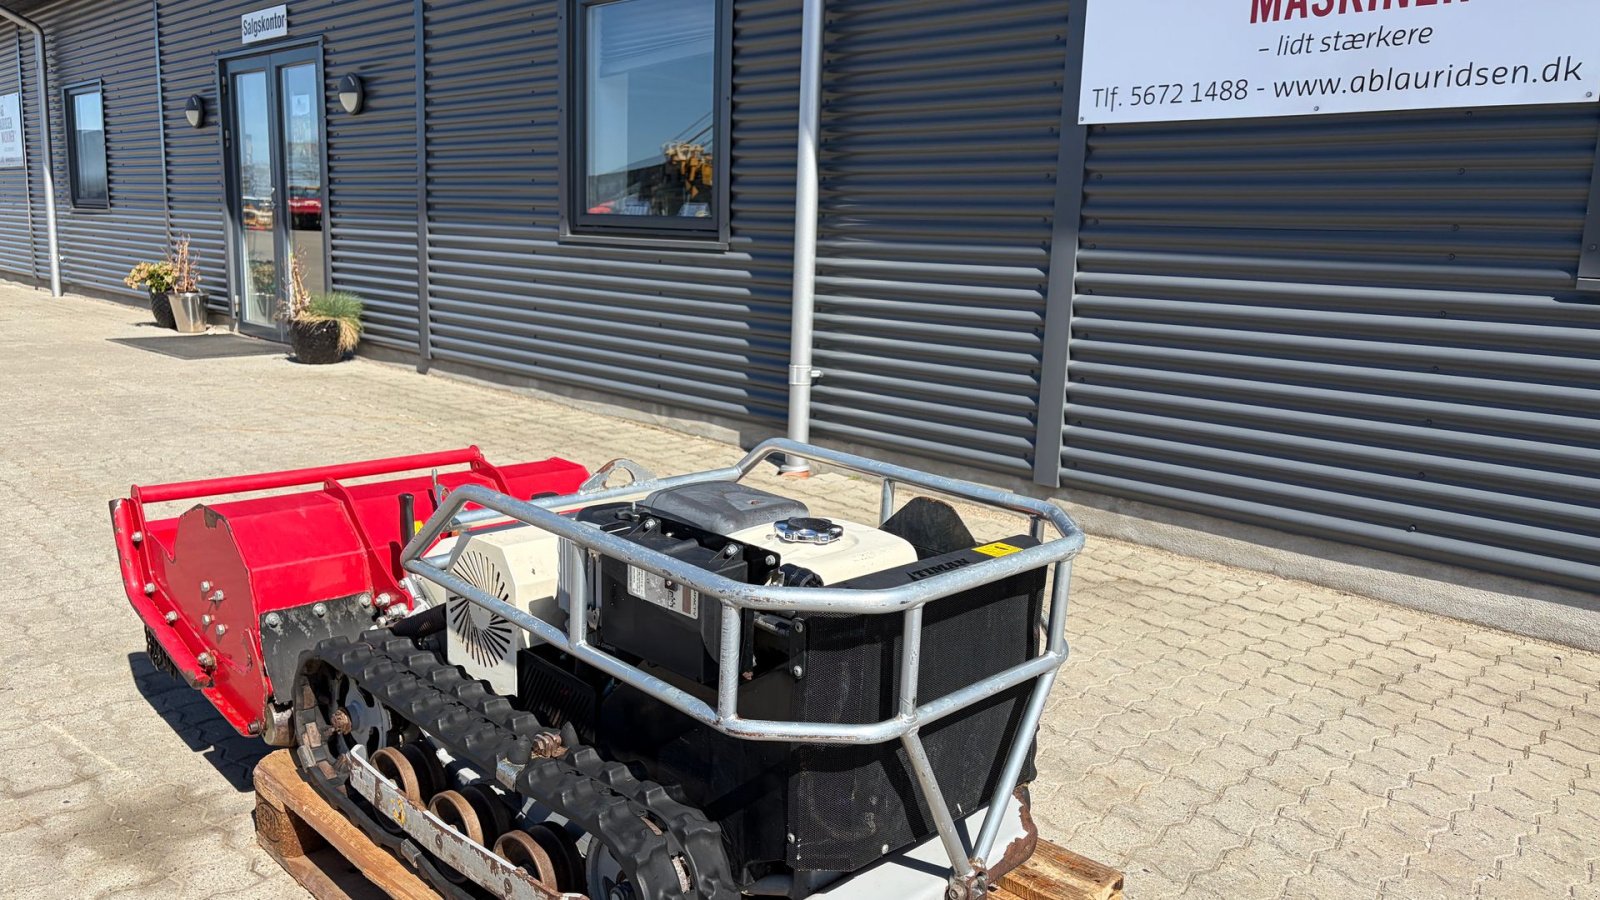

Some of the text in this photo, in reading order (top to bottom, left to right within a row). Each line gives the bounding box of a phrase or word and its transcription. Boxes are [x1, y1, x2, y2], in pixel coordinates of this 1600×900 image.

[243, 13, 285, 37] Salgskontor
[1277, 33, 1315, 56] lidt
[1319, 25, 1434, 53] stærkere
[1092, 86, 1123, 112] Tlf.
[1130, 83, 1183, 106] 5672
[1189, 79, 1249, 103] 1488
[1273, 55, 1584, 98] www.ablauridsen.dk
